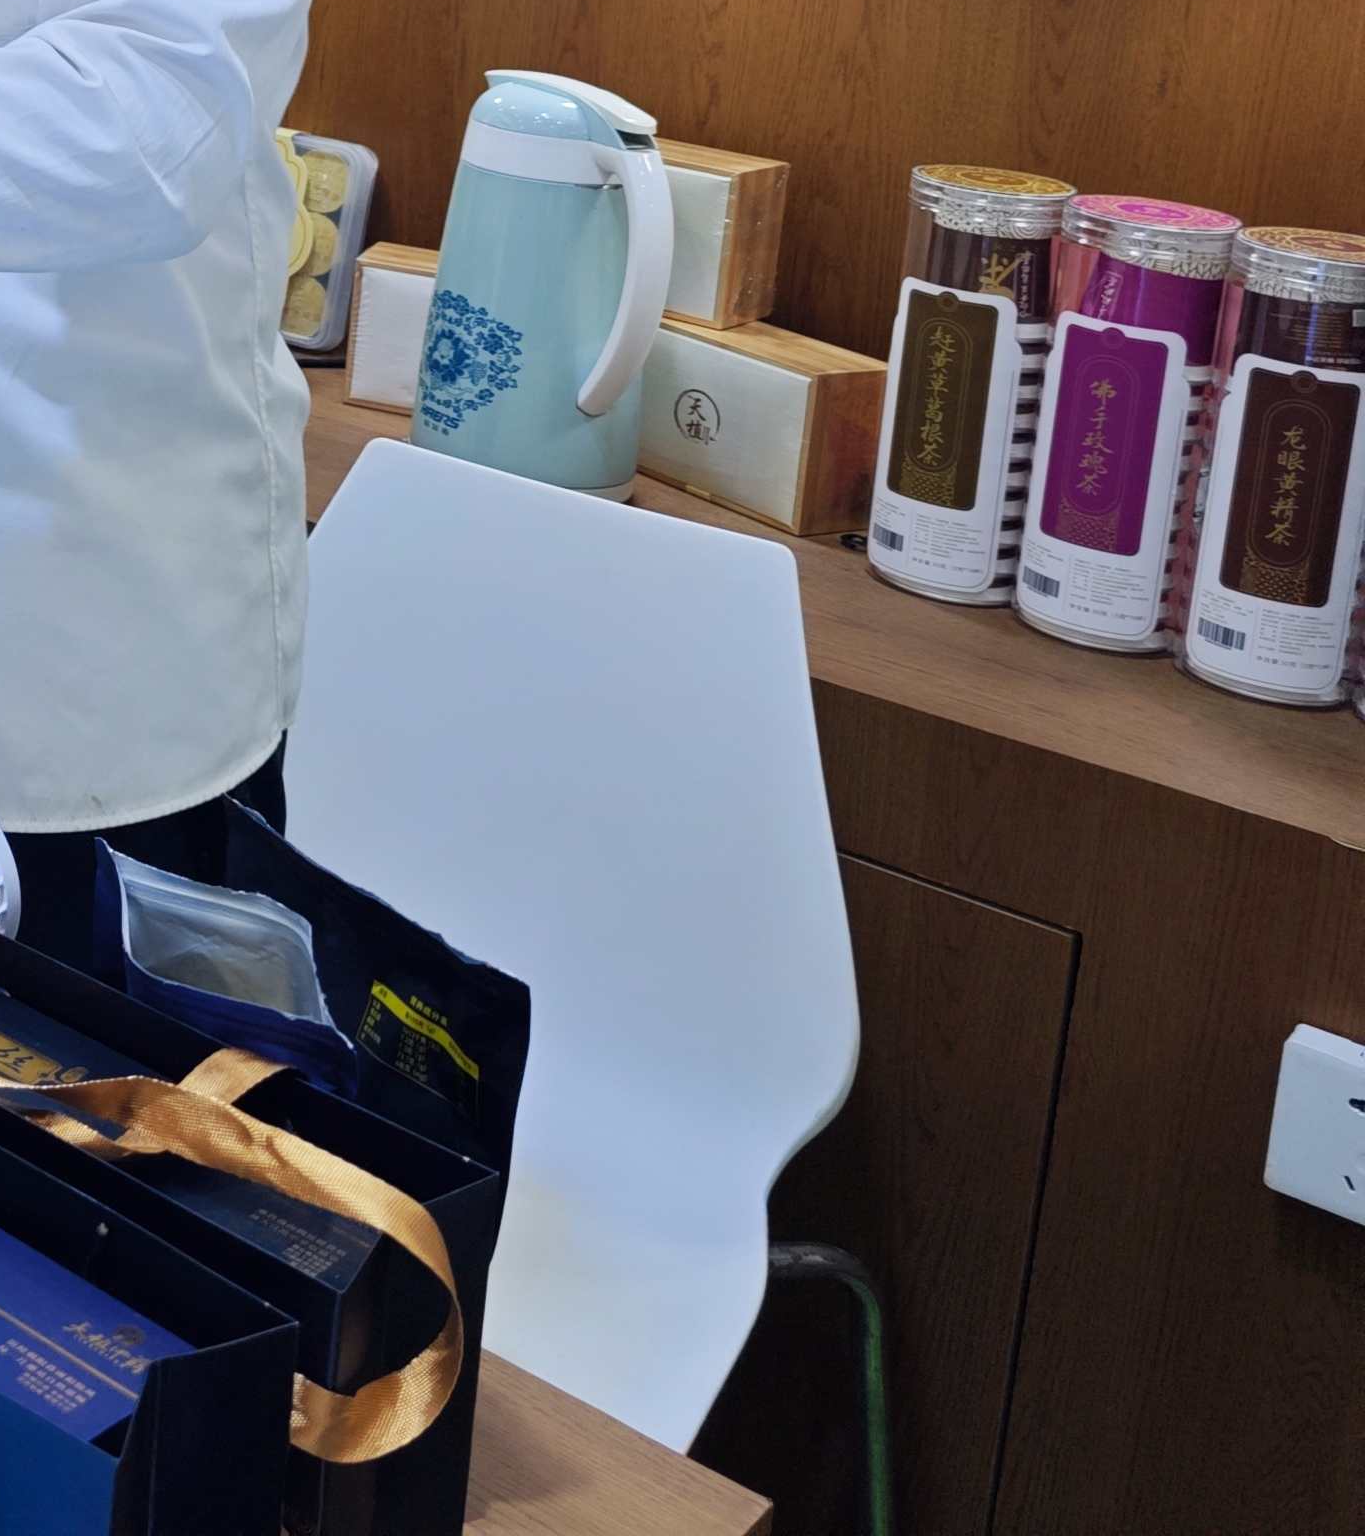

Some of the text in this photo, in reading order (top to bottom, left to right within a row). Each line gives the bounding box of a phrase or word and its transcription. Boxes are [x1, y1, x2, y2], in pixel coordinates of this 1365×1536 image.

[916, 324, 956, 467] 赶黄草葛根茶
[1265, 424, 1307, 547] 龙眼黄精茶
